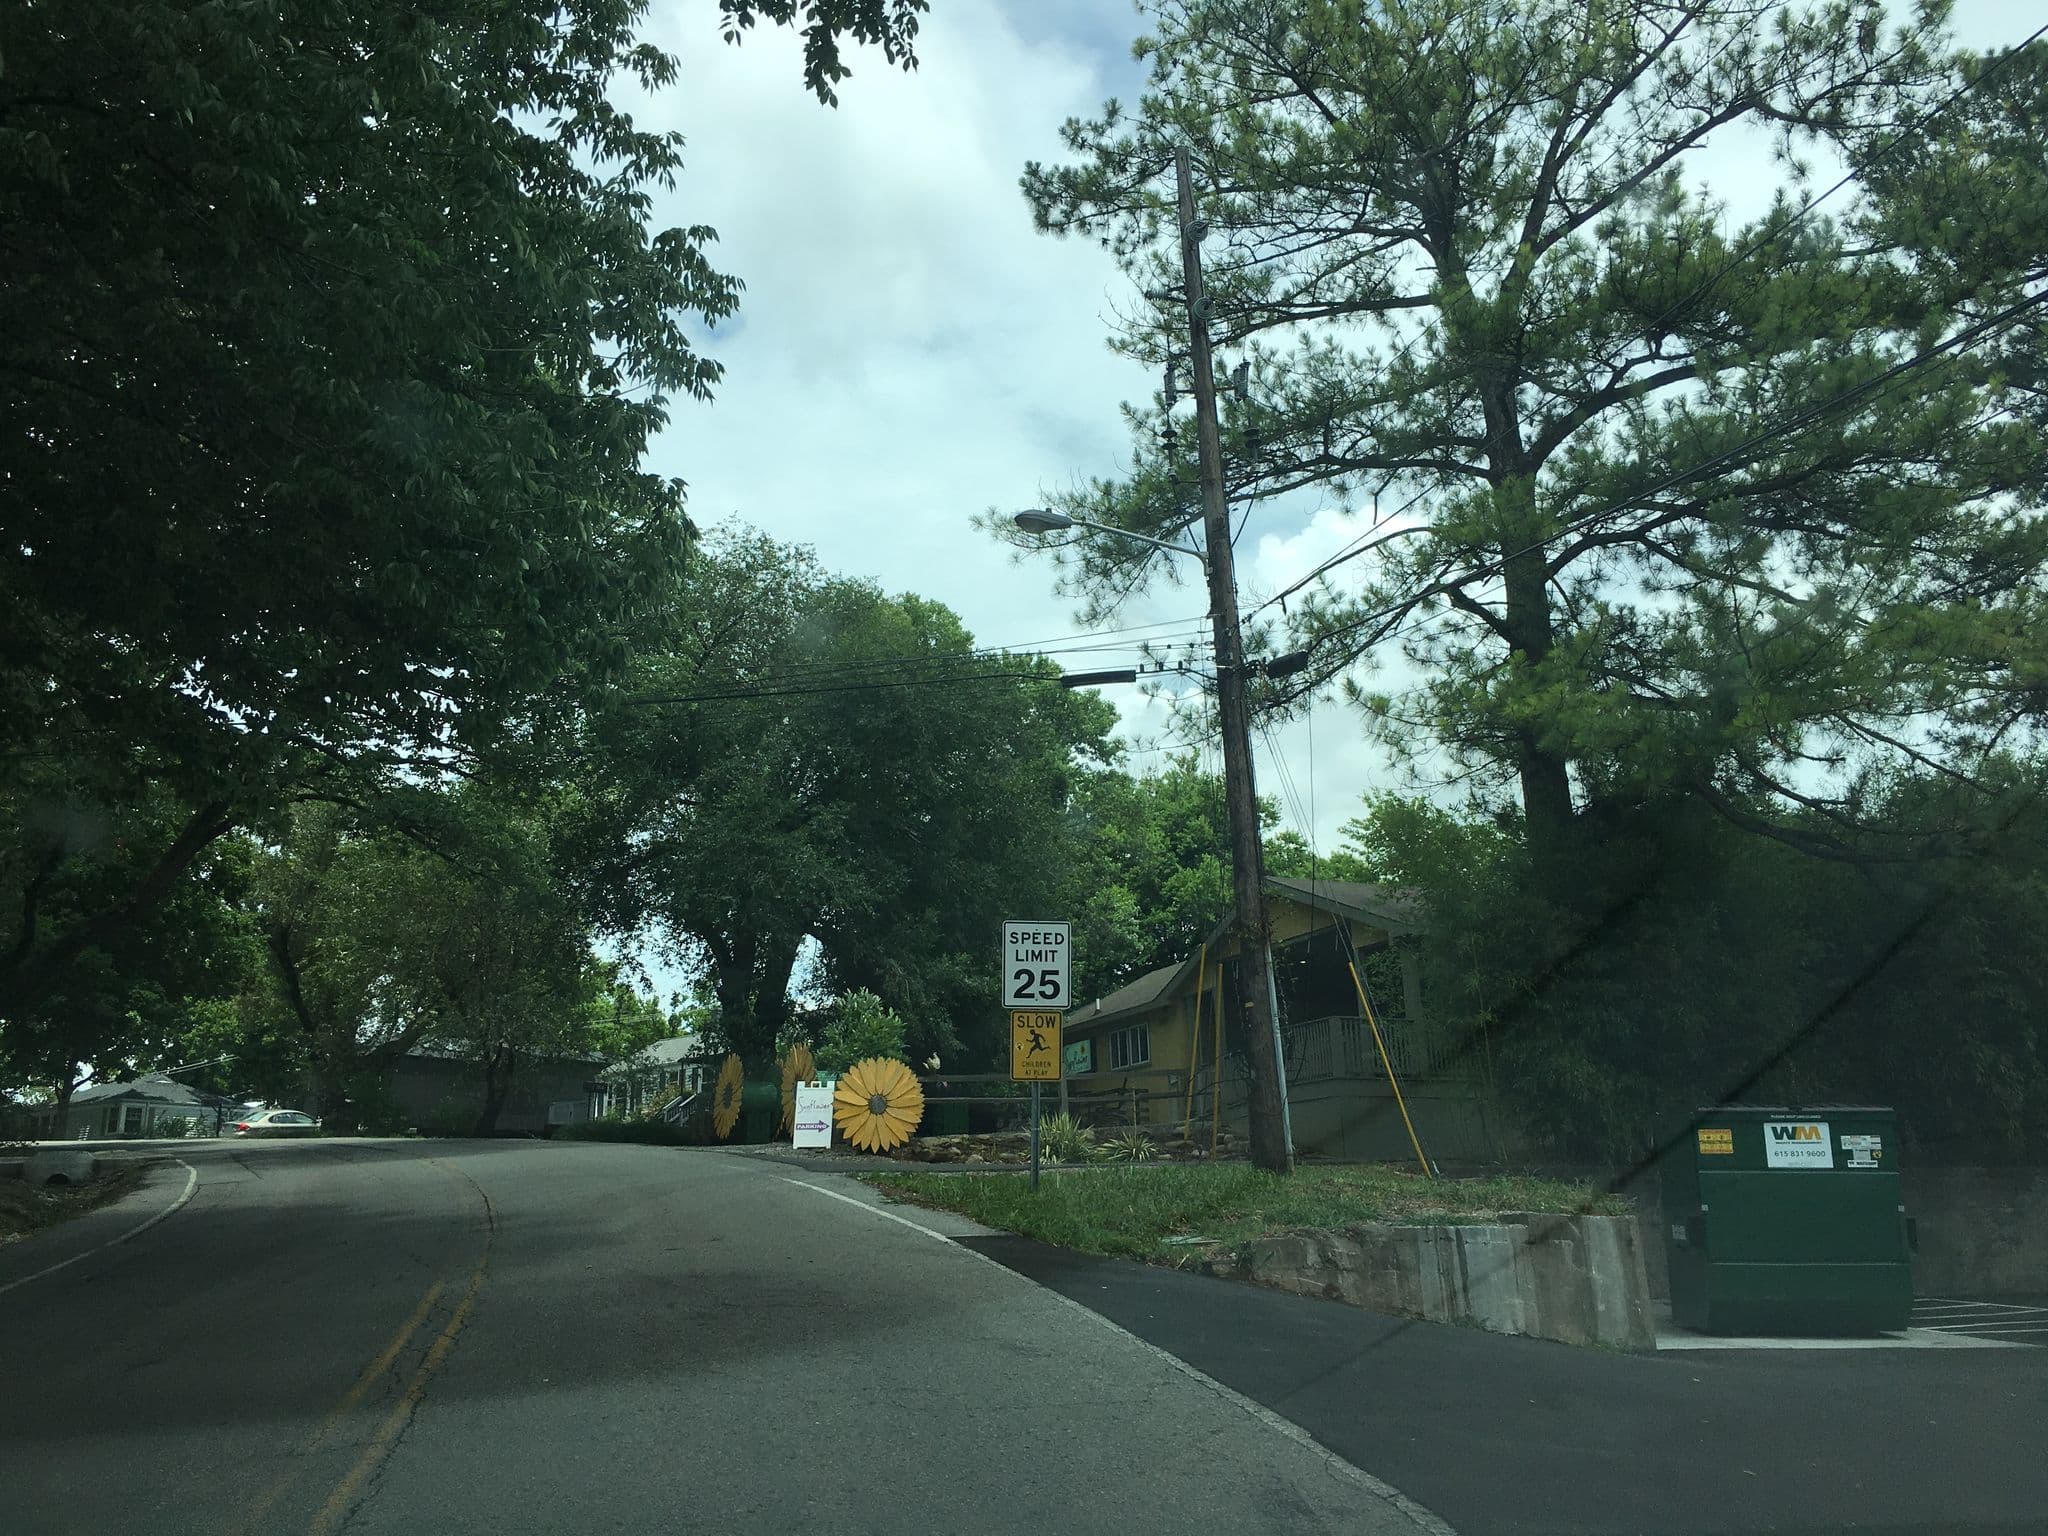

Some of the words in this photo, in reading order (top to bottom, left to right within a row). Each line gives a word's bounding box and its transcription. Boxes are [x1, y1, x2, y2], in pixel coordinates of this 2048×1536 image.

[1009, 932, 1065, 945] SPEED
[1015, 949, 1058, 962] LIMIT
[1013, 968, 1061, 1000] 25
[1017, 1015, 1056, 1029] SLOW
[1021, 1060, 1052, 1068] CHILDREN
[1771, 1126, 1822, 1140] WM
[1774, 1150, 1788, 1158] 615
[1790, 1150, 1804, 1158] 831
